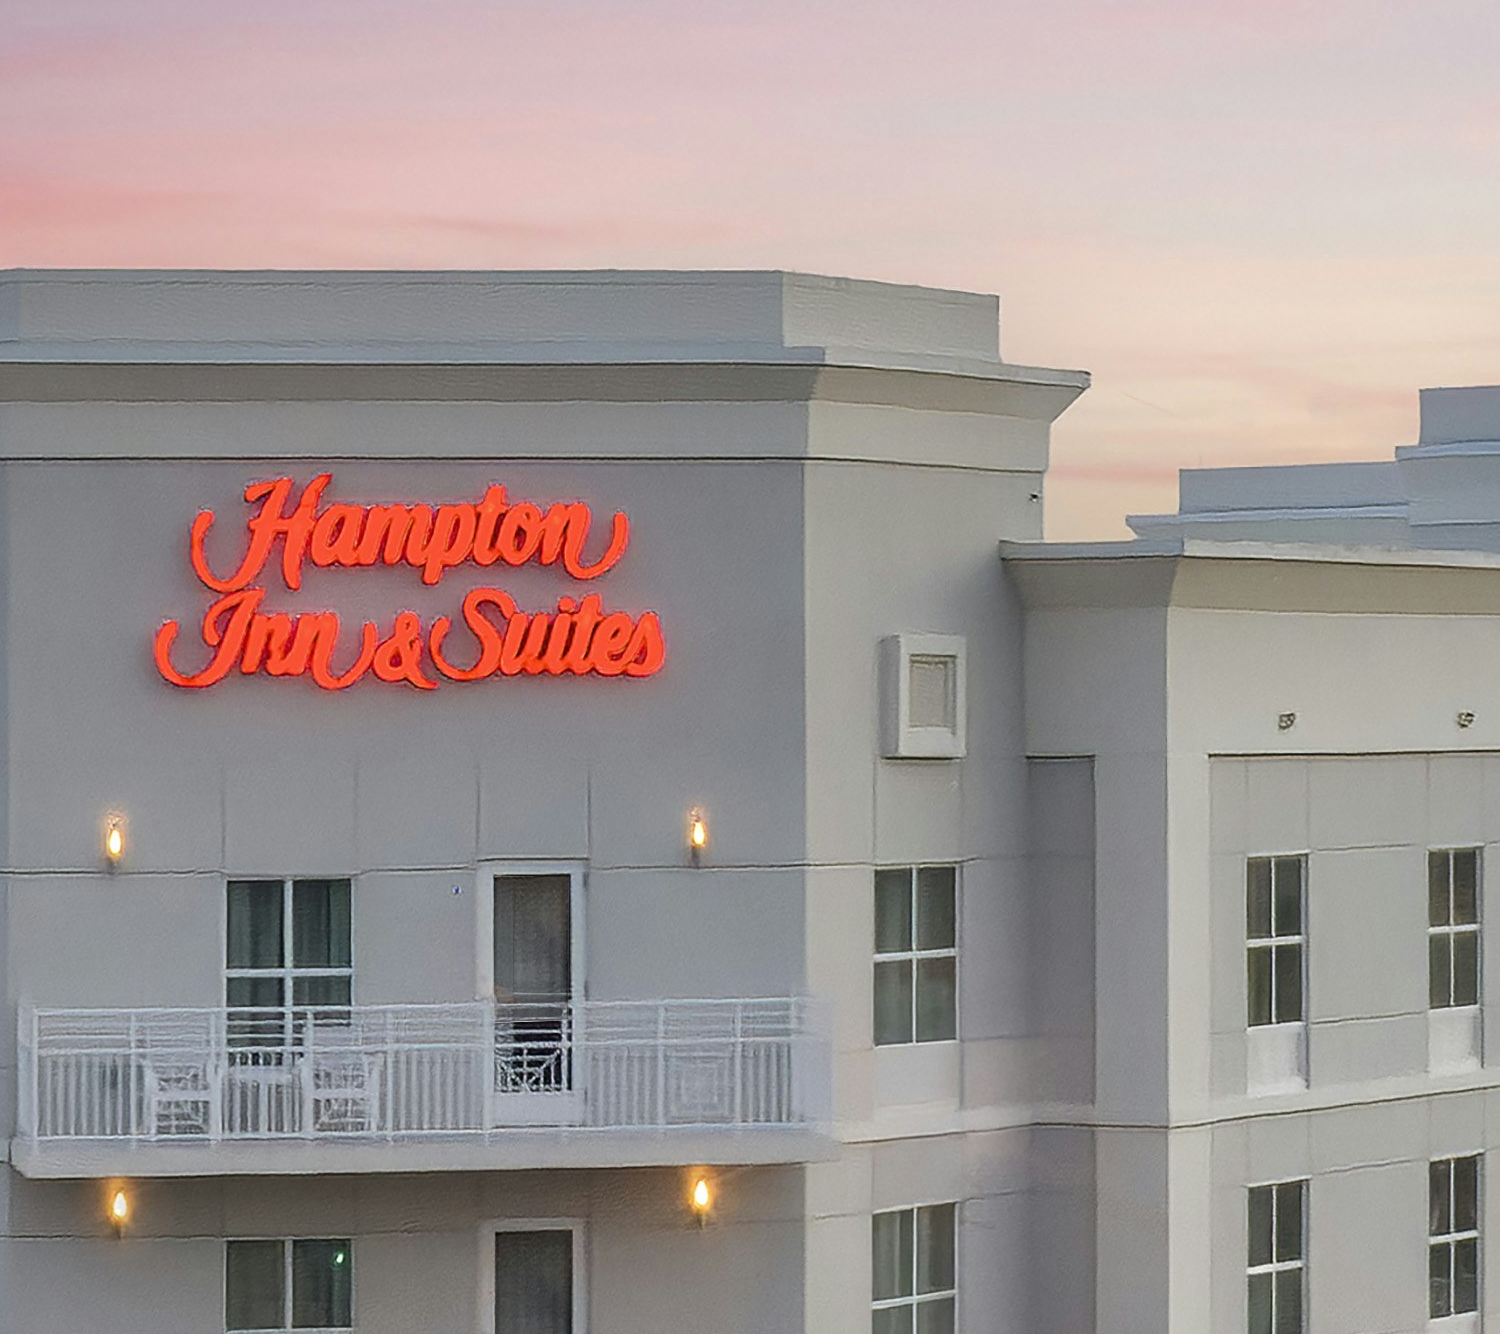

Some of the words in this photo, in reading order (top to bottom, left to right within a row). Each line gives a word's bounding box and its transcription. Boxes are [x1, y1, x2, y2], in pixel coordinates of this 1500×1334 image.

[190, 473, 630, 593] Hampton
[154, 588, 378, 690] Inn
[373, 610, 439, 691] &
[429, 587, 666, 682] Suites
